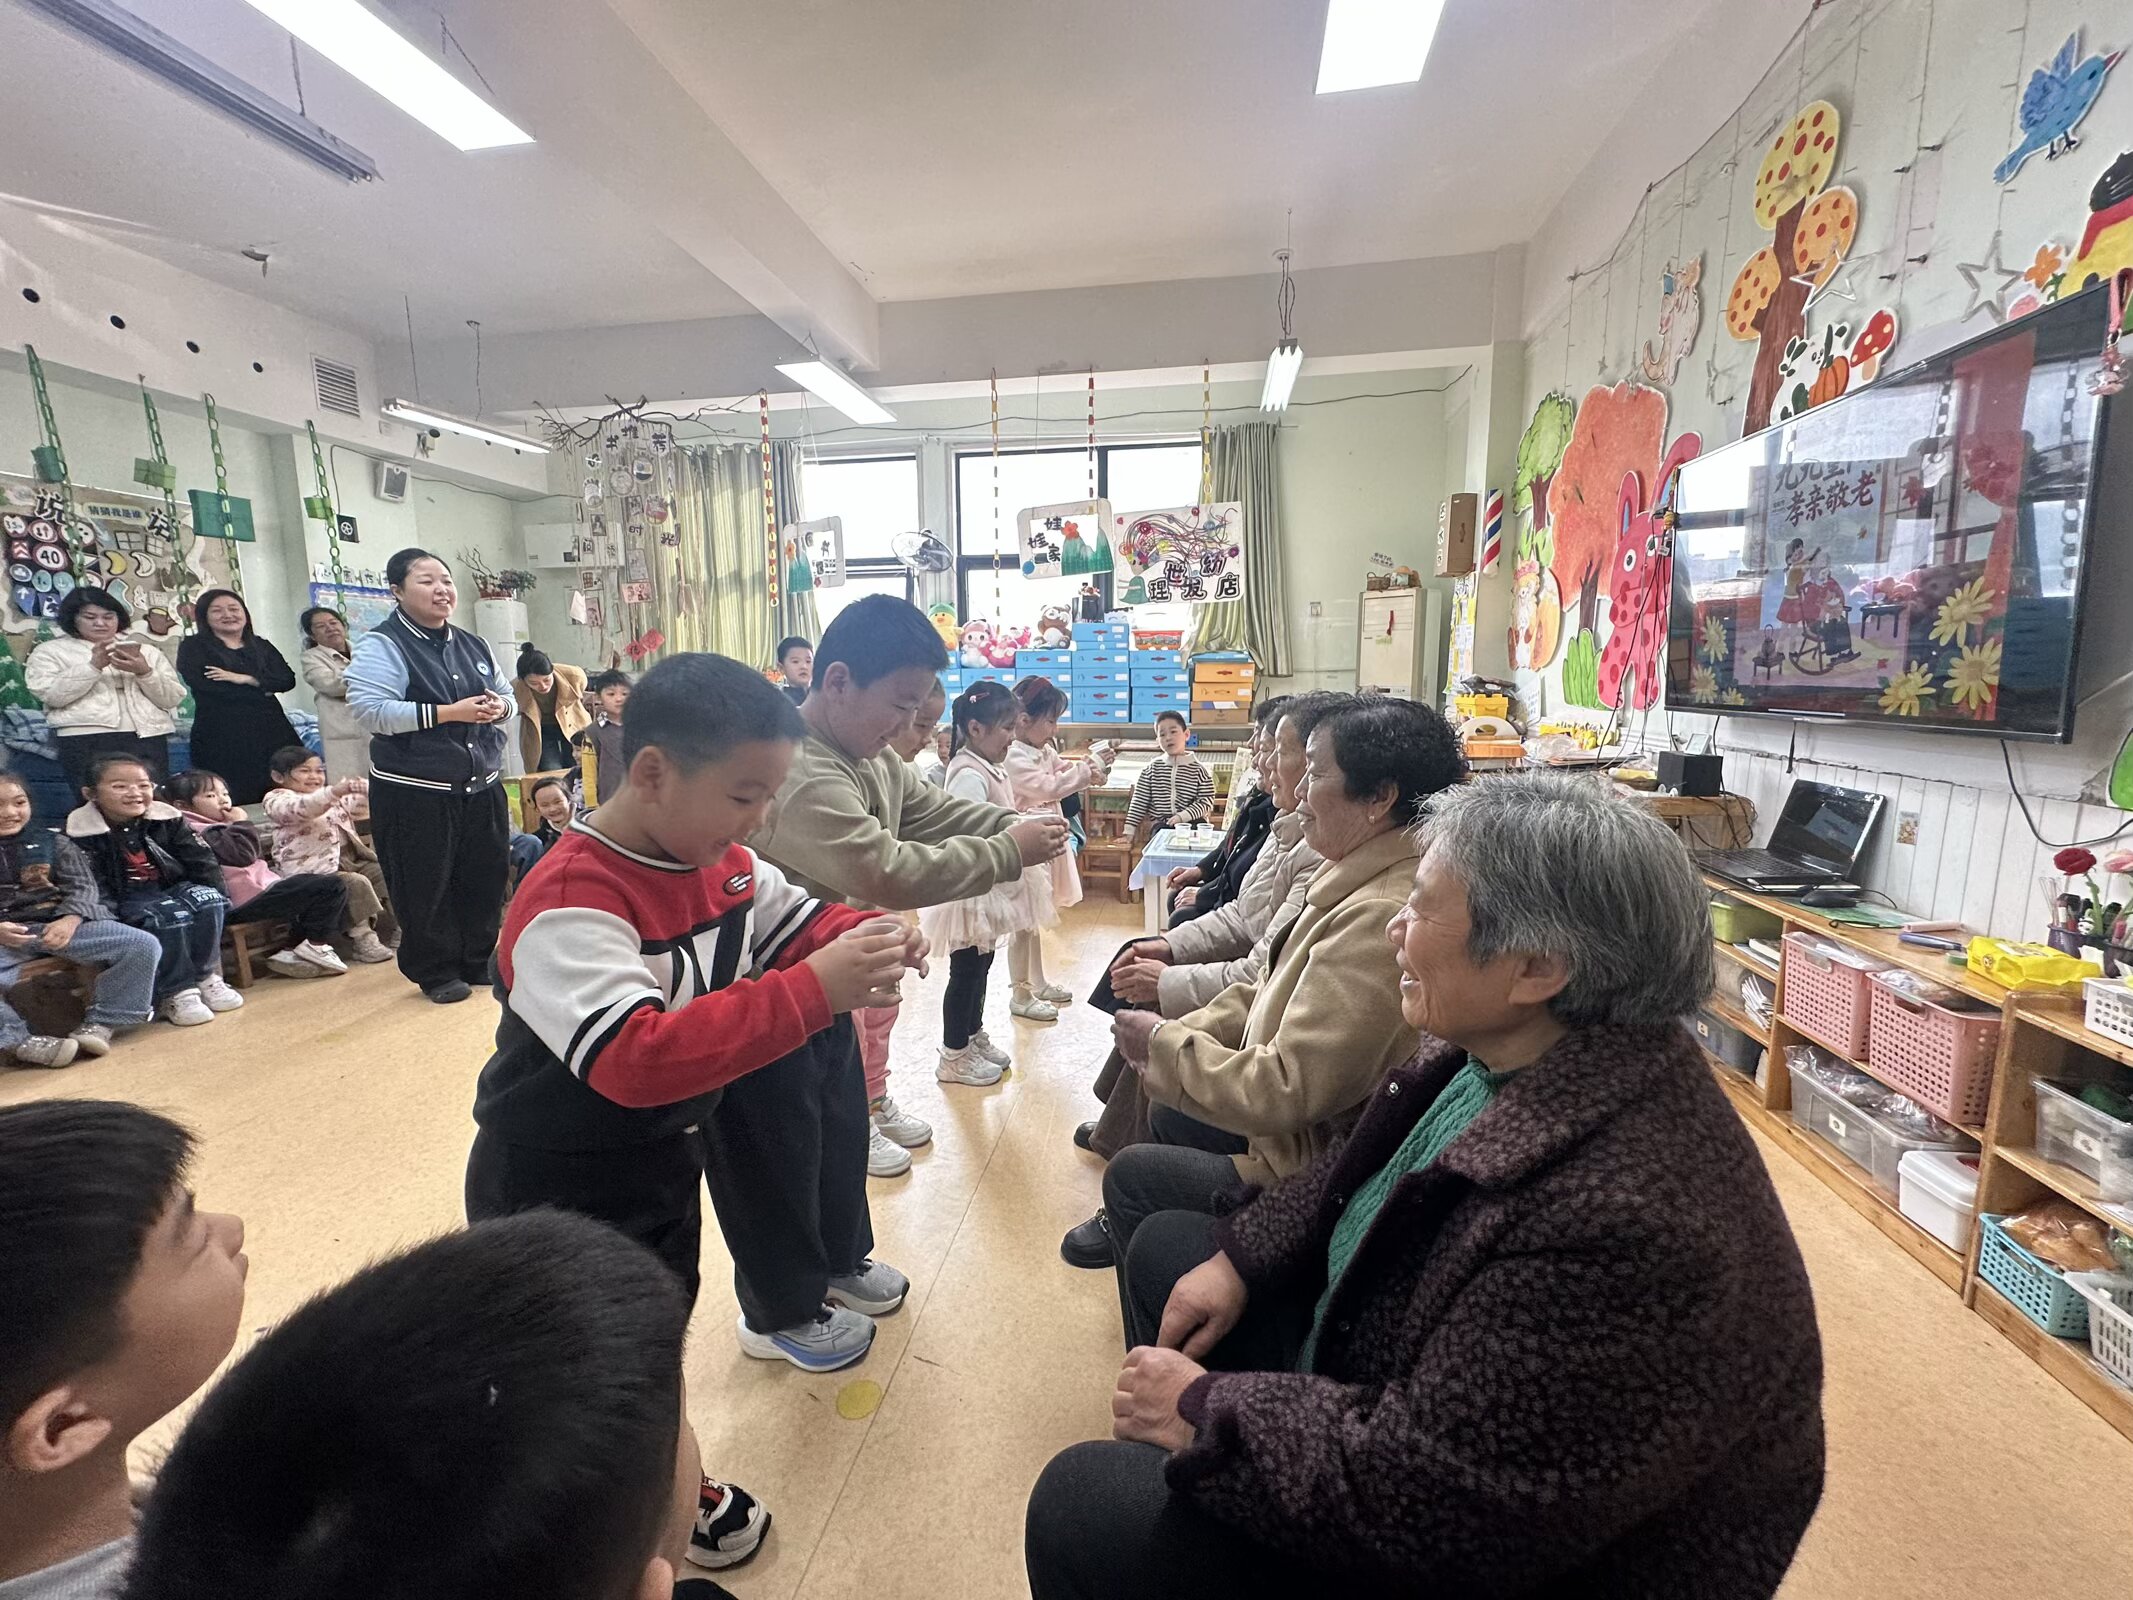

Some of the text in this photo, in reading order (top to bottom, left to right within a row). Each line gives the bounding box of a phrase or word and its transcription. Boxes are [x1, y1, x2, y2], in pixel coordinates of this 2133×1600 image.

[1784, 470, 1877, 527] 孝亲敬老
[40, 550, 60, 565] 40
[1149, 572, 1240, 603] 理发店
